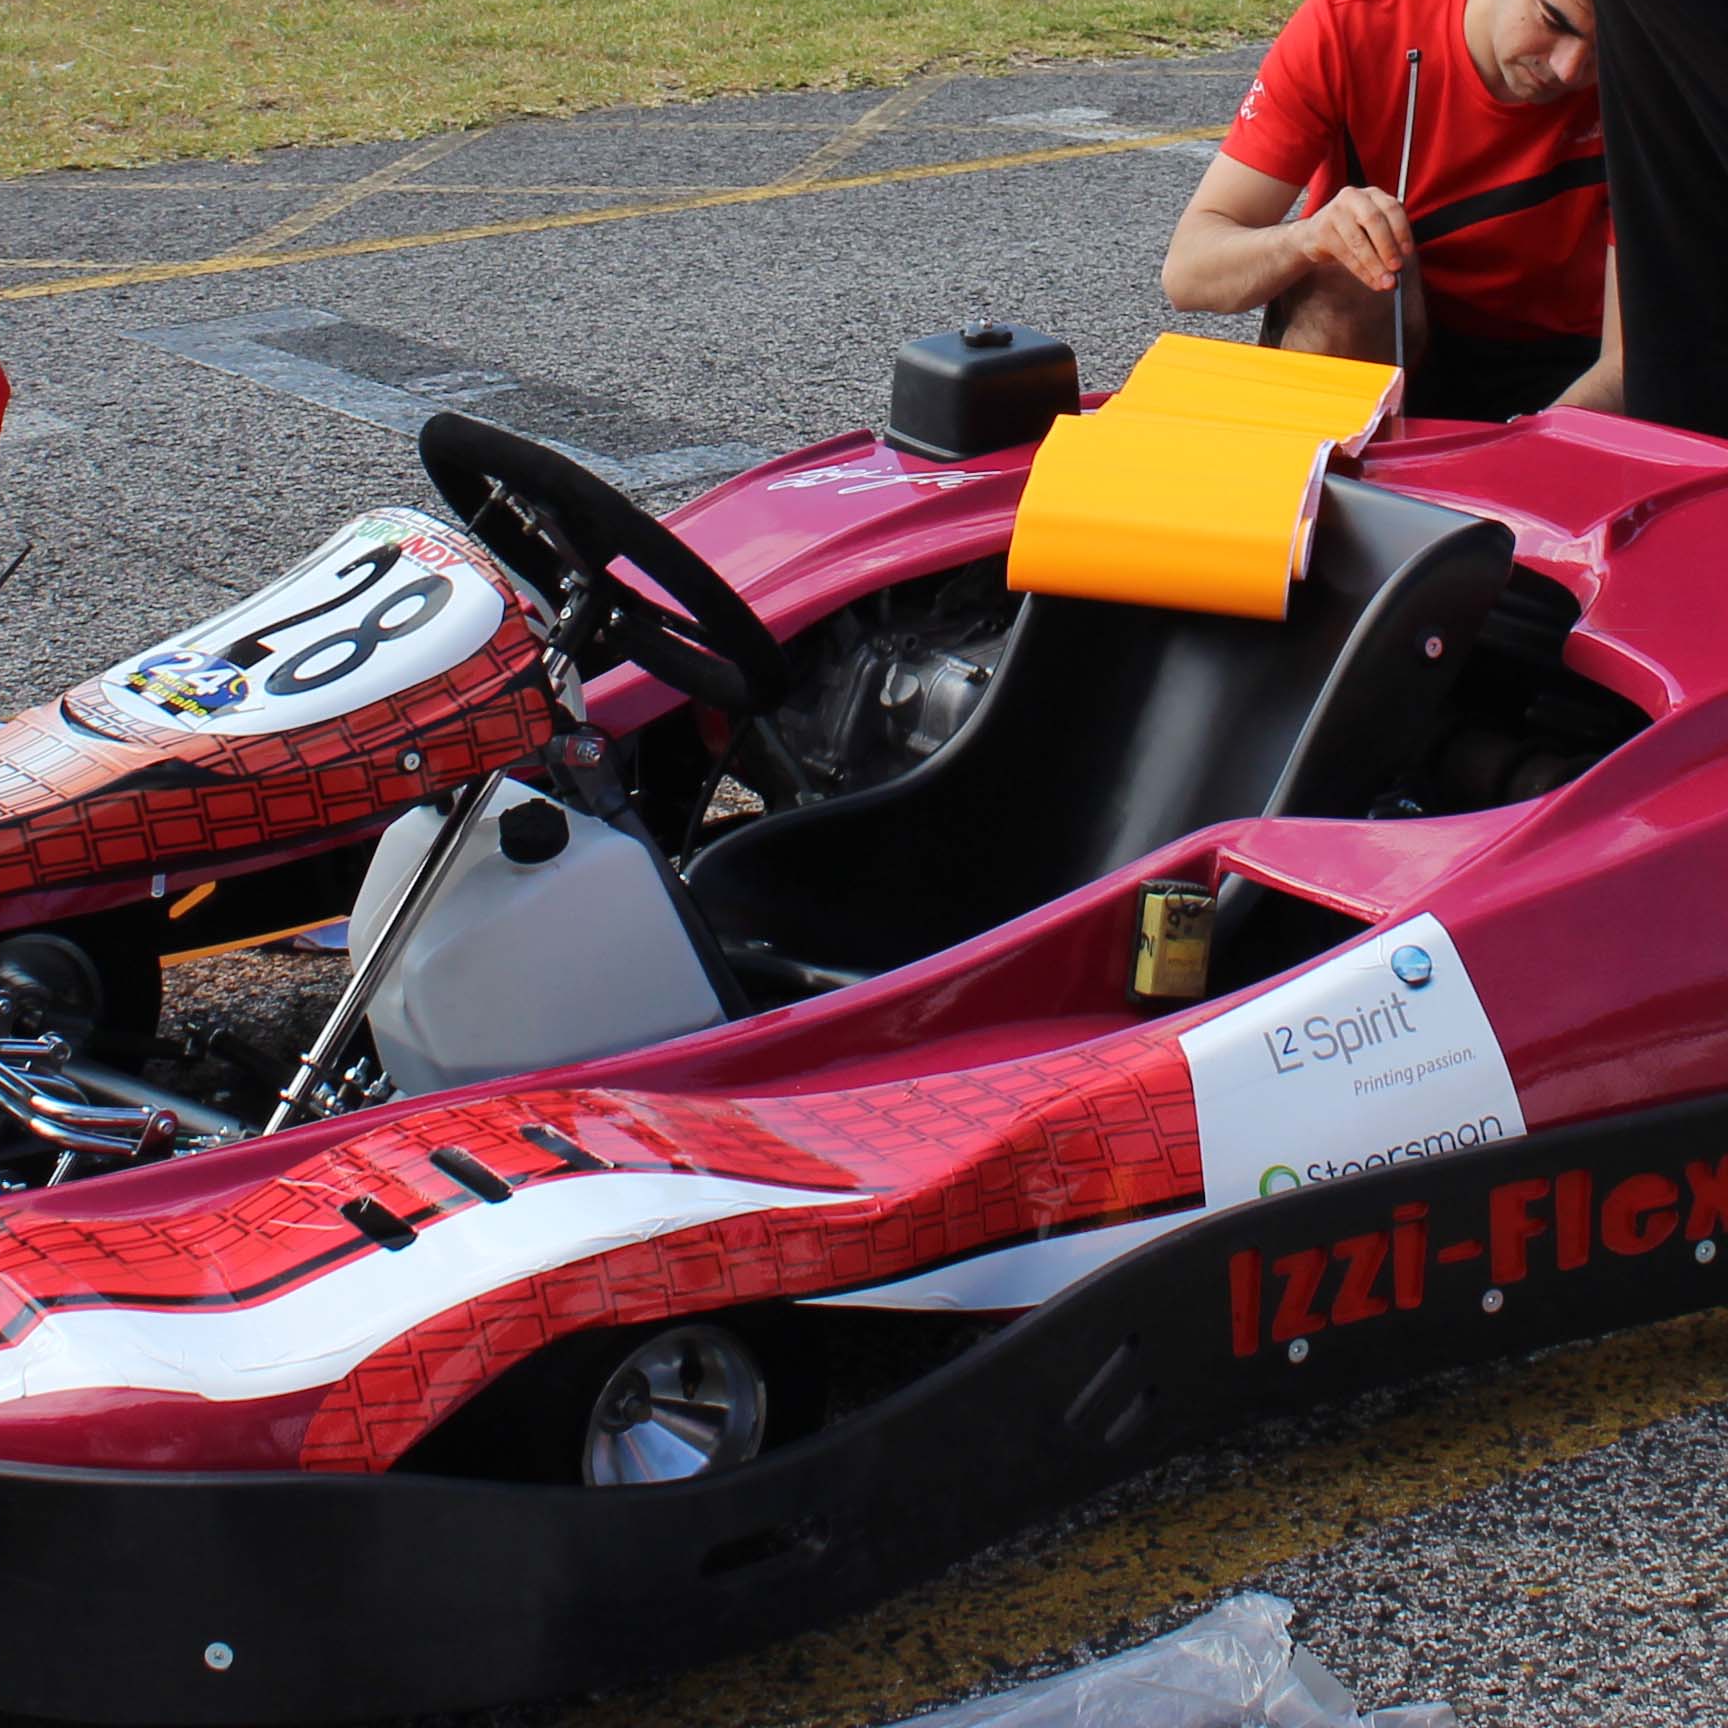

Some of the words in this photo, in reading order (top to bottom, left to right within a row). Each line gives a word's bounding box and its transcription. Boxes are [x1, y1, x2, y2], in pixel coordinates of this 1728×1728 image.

[211, 542, 454, 698] 28
[148, 651, 239, 697] 24
[1302, 991, 1417, 1065] Spirit
[1353, 1068, 1415, 1097] Printing
